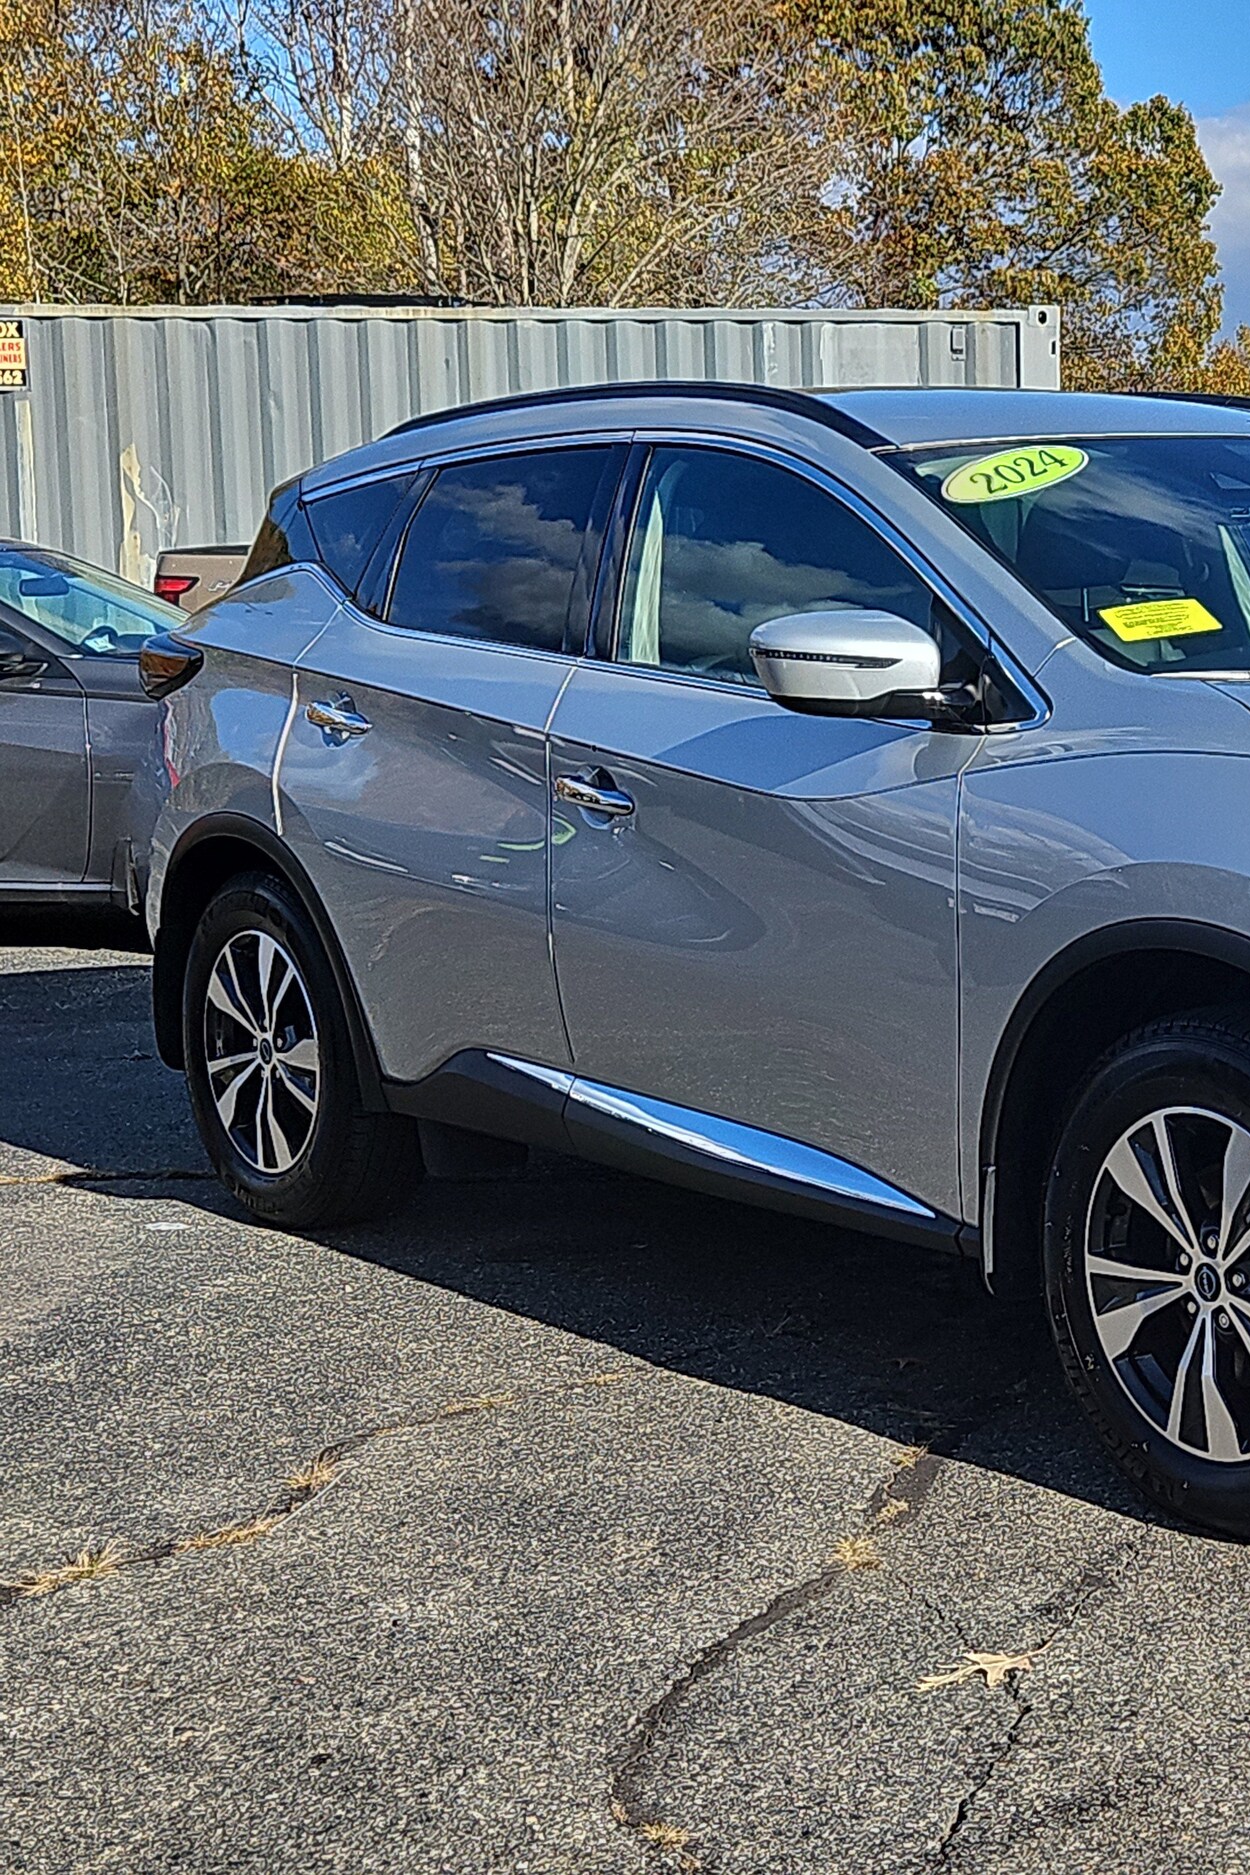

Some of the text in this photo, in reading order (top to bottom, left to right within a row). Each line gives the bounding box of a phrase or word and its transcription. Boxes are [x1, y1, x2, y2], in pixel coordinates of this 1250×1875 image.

[0, 342, 21, 352] ERS
[0, 369, 24, 385] 62
[969, 449, 1069, 494] 2024
